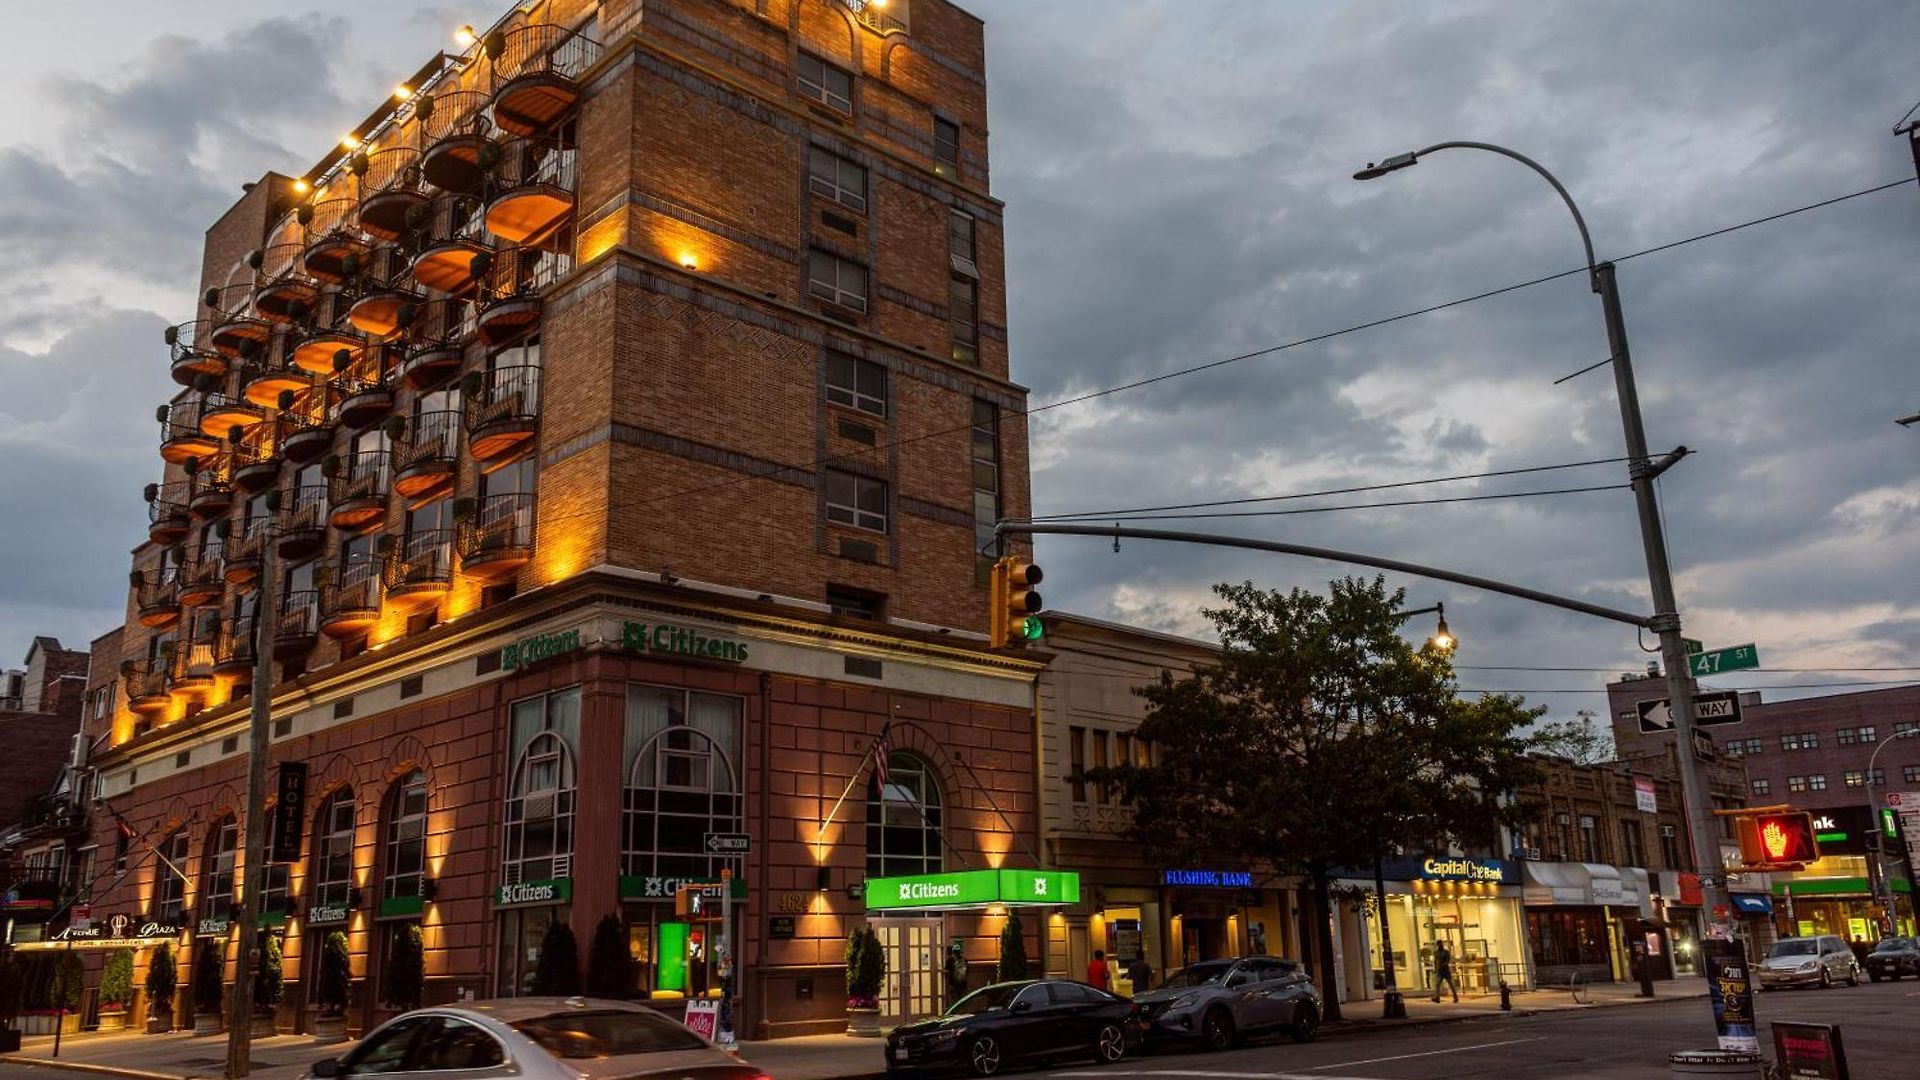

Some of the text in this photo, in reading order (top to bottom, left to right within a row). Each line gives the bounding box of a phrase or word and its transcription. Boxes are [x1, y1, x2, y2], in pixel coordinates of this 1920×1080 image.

[517, 628, 580, 663] Citizens
[653, 625, 748, 663] Citizens
[1696, 648, 1749, 673] 47 ST
[1698, 702, 1728, 716] WAY
[285, 774, 299, 848] HOTEL
[1812, 816, 1835, 830] nk
[1166, 870, 1251, 886] FLUSHING BANK
[1424, 859, 1467, 877] Capital
[1484, 867, 1503, 880] Bank
[512, 883, 554, 903] Citizens
[911, 882, 959, 898] Citizens
[316, 906, 347, 922] Citizens
